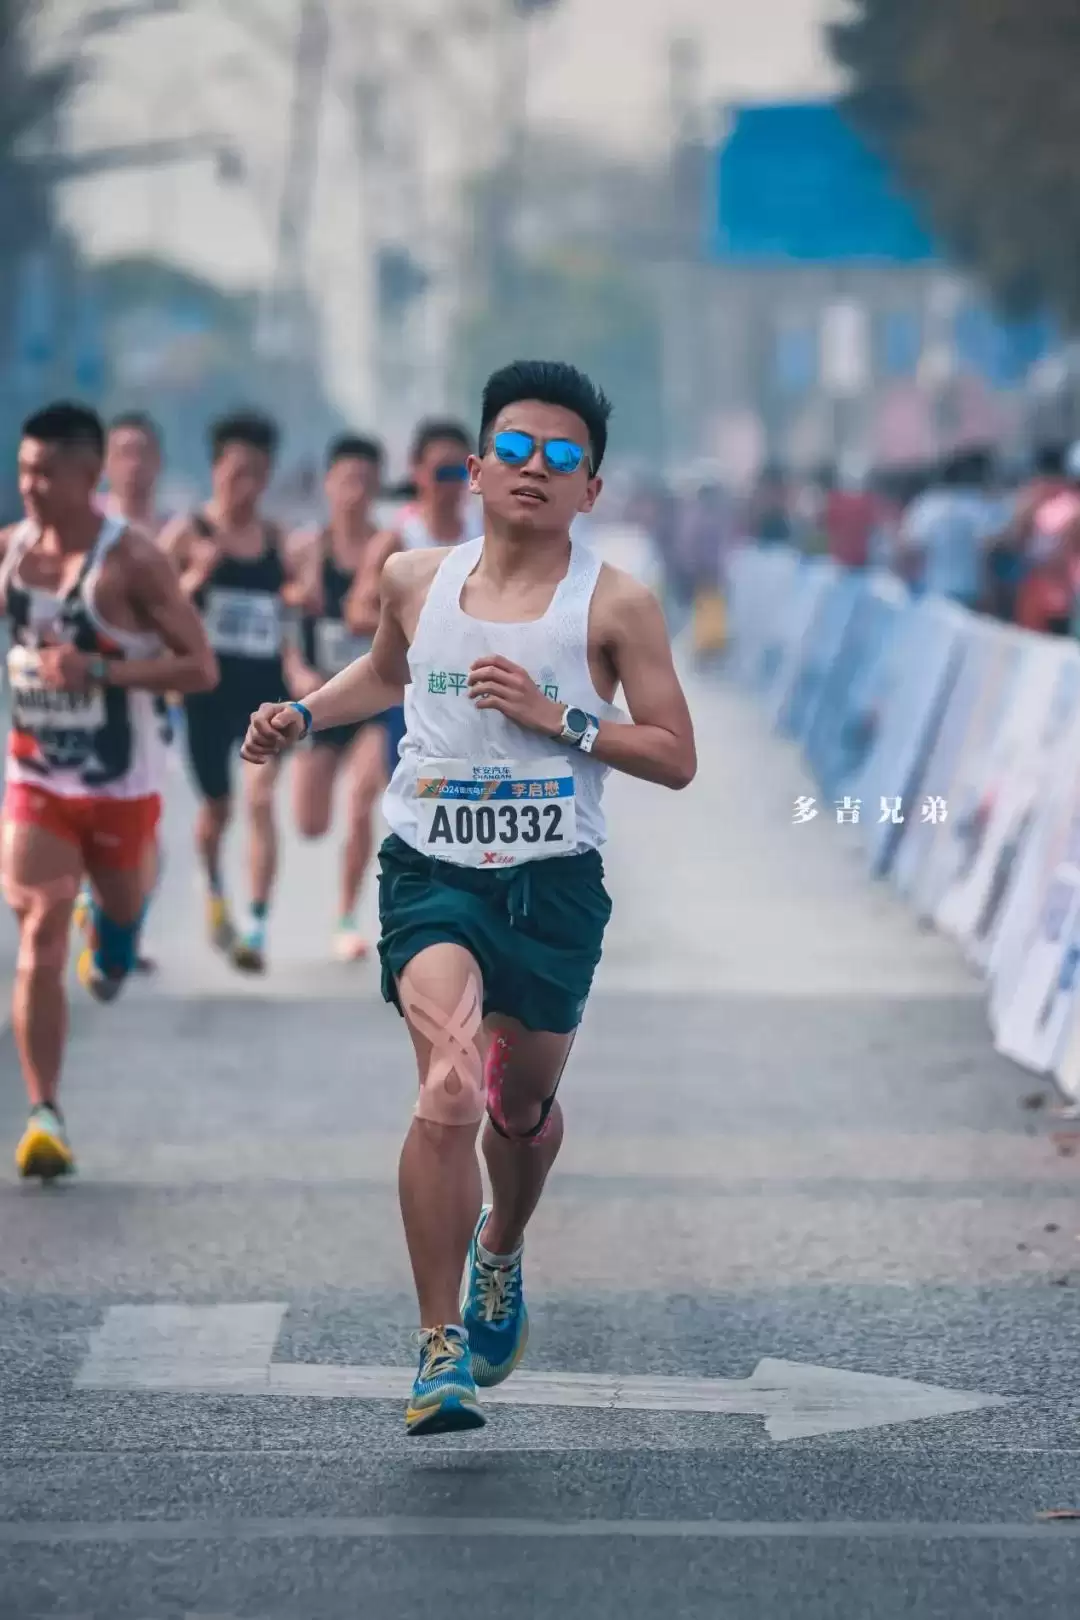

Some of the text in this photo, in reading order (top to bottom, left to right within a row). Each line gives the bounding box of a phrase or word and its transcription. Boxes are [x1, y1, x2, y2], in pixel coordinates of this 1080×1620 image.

[472, 766, 512, 775] 长安汽车
[428, 804, 564, 844] A00332
